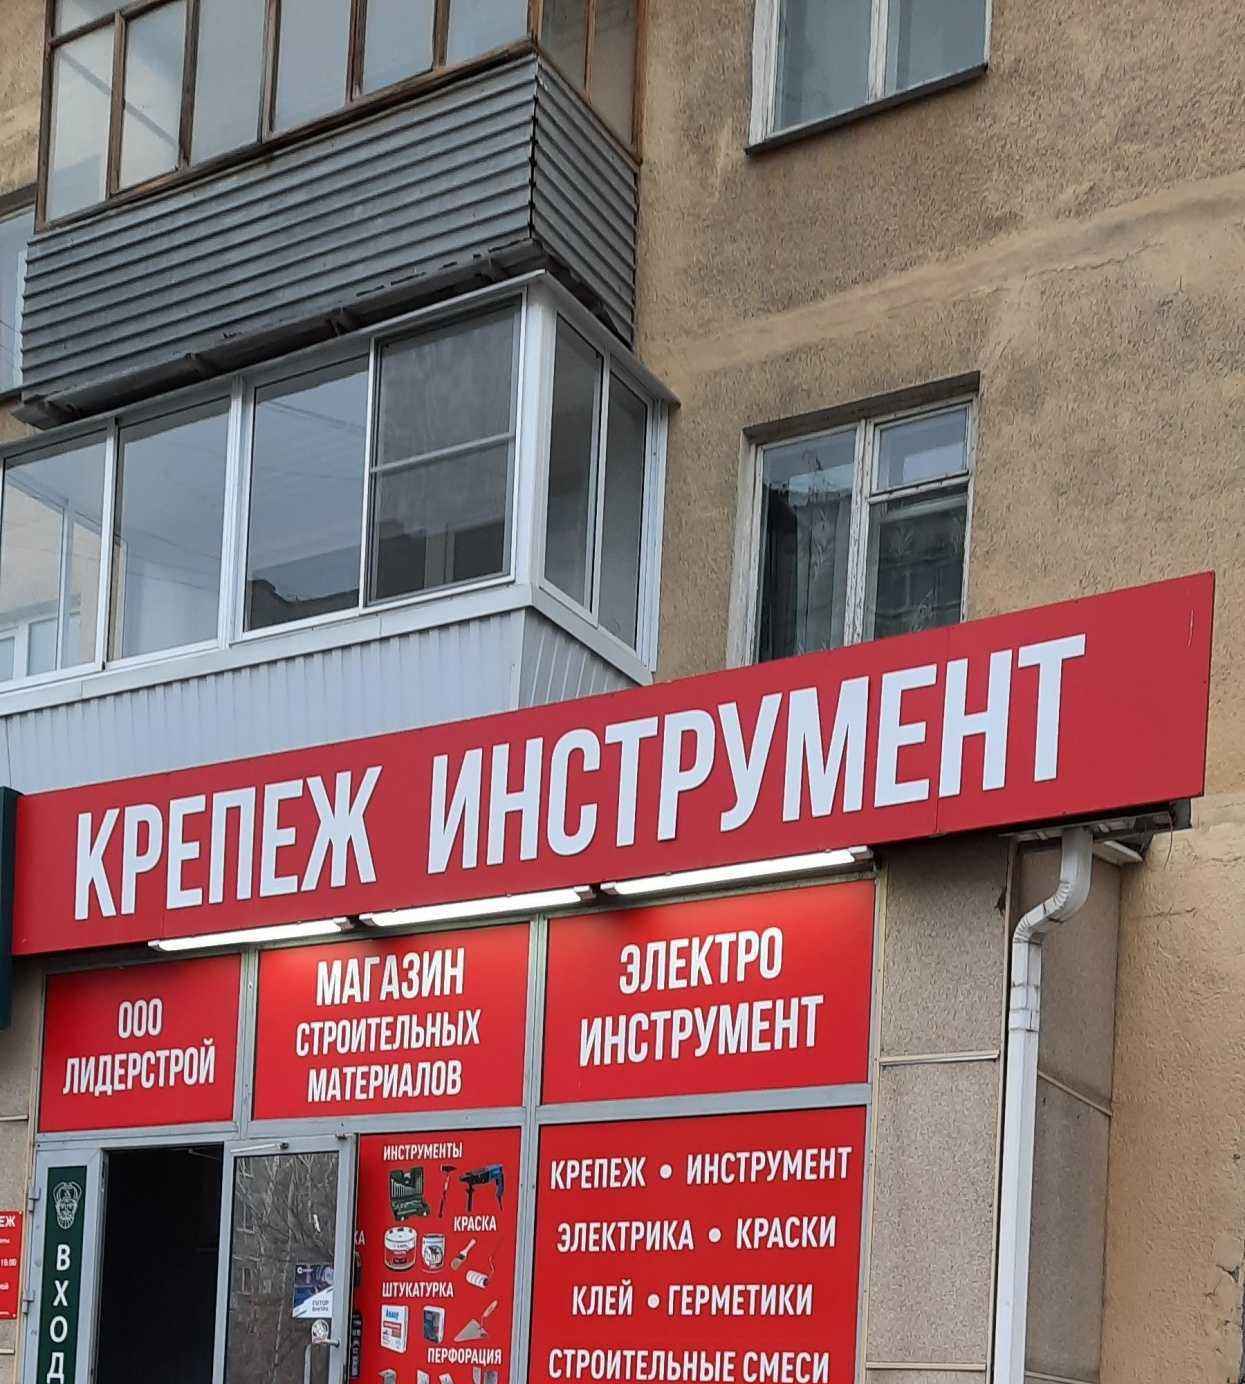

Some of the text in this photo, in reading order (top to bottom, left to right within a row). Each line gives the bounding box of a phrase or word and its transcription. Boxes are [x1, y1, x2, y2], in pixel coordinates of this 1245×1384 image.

[74, 633, 1086, 921] КРЕПЕЖ ИНСТРУМЕНТ
[315, 948, 465, 1006] МАГАЗИН
[618, 927, 783, 994] ЭЛЕКТРО
[118, 998, 163, 1038] ООО
[295, 1009, 481, 1058] СТРОИТЕЛЬНЫХ
[579, 995, 824, 1067] ИНСТРУМЕНТ
[63, 1038, 215, 1096] ЛИДЕРСТРОЙ
[307, 1060, 462, 1103] МАТЕРИАЛОВ
[383, 1142, 463, 1161] ИНСТРУМЕНТЫ
[550, 1146, 852, 1190] КРЕПЕЖ ИНСТРУМЕНТ
[453, 1215, 497, 1232] КРАСКА
[557, 1215, 837, 1253] ЭЛЕКТРИКА КРАСКИ
[382, 1281, 454, 1298] ШТУКАТУРКА
[572, 1279, 813, 1316] КЛЕЙ ГЕРМЕТИКИ
[47, 1244, 71, 1384] ВХОД
[427, 1347, 502, 1367] ПЕРФОРАЦИЯ
[548, 1348, 829, 1384] СТРОИТЕЛЬНЫЕ СМЕСИ
